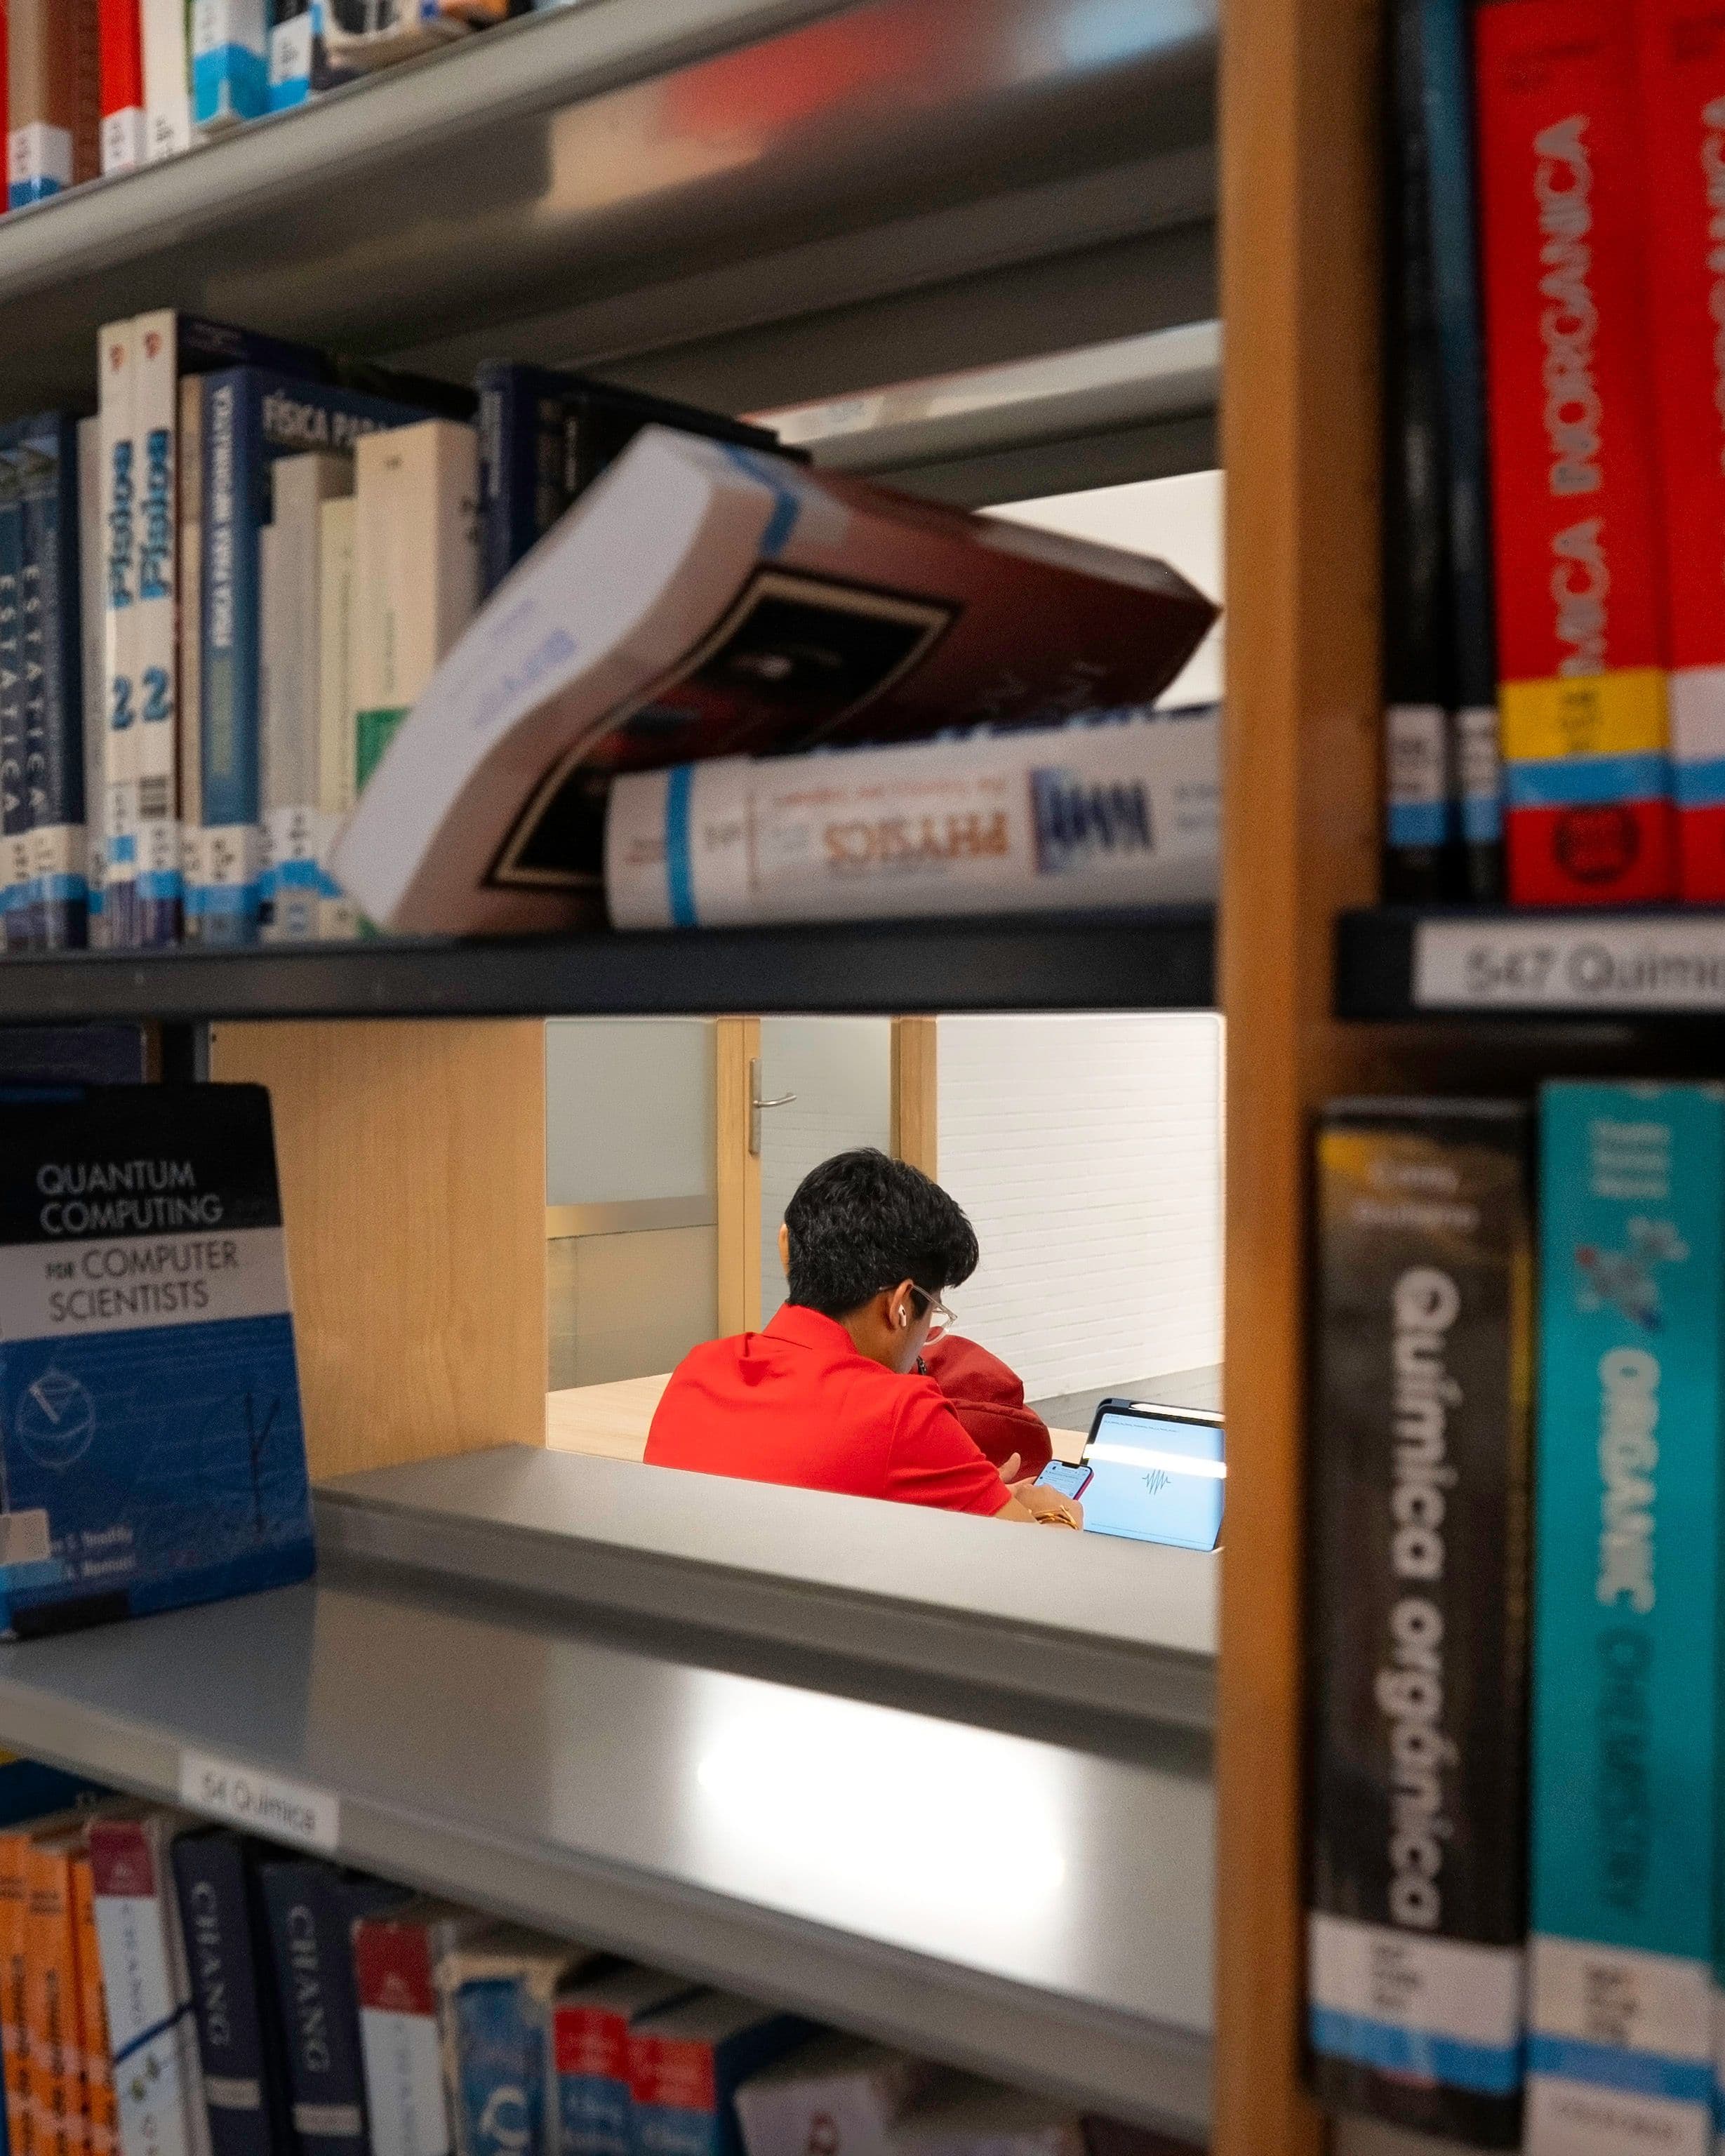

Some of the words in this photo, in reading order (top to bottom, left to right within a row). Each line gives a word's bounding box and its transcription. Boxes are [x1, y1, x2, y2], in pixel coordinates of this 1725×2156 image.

[1550, 517, 1610, 676] MICA
[822, 807, 1012, 863] PHYSICS
[37, 1158, 197, 1197] QUANTUM
[40, 1193, 224, 1236] COMPUTING
[46, 1261, 74, 1281] FOR
[82, 1240, 239, 1281] COMPUTER
[48, 1278, 210, 1324] SCIENTISTS
[1390, 1266, 1465, 1581] Química
[1373, 1596, 1462, 1929] orgánica
[190, 1879, 233, 2048] CHANG
[286, 1905, 331, 2072] CHANG
